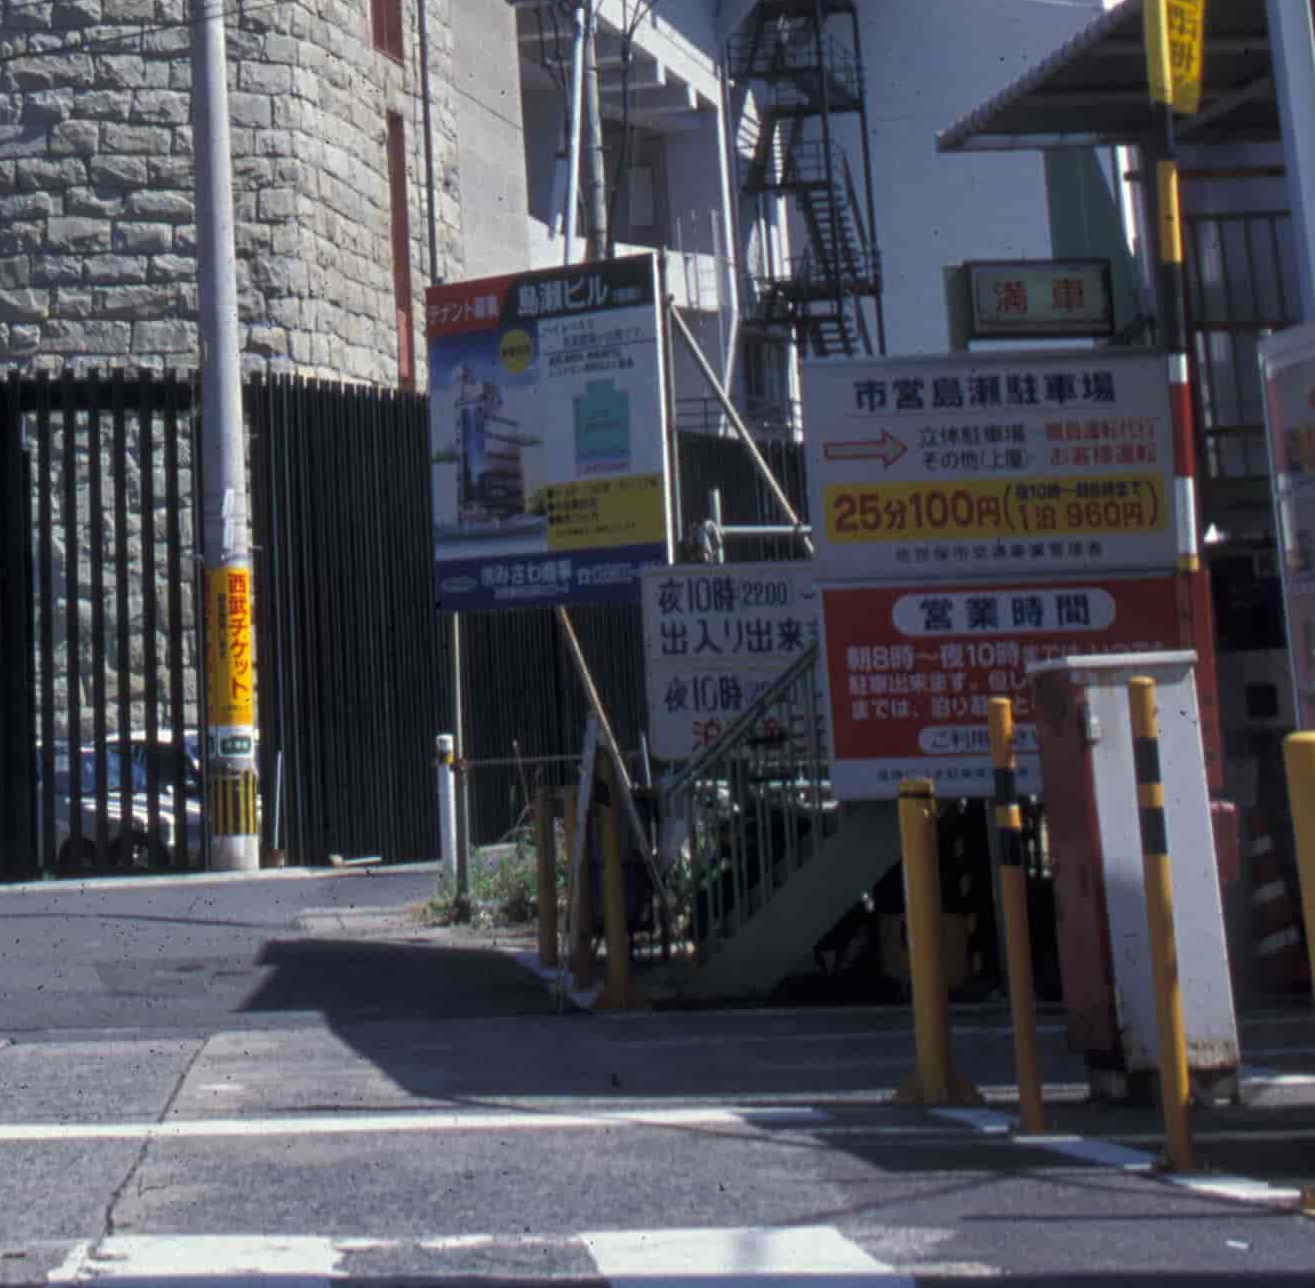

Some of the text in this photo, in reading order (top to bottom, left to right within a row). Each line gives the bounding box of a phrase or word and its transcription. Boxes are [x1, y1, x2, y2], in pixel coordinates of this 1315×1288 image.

[854, 371, 1117, 412] 市営島瀬駐車場
[919, 593, 1091, 632] 営業時間
